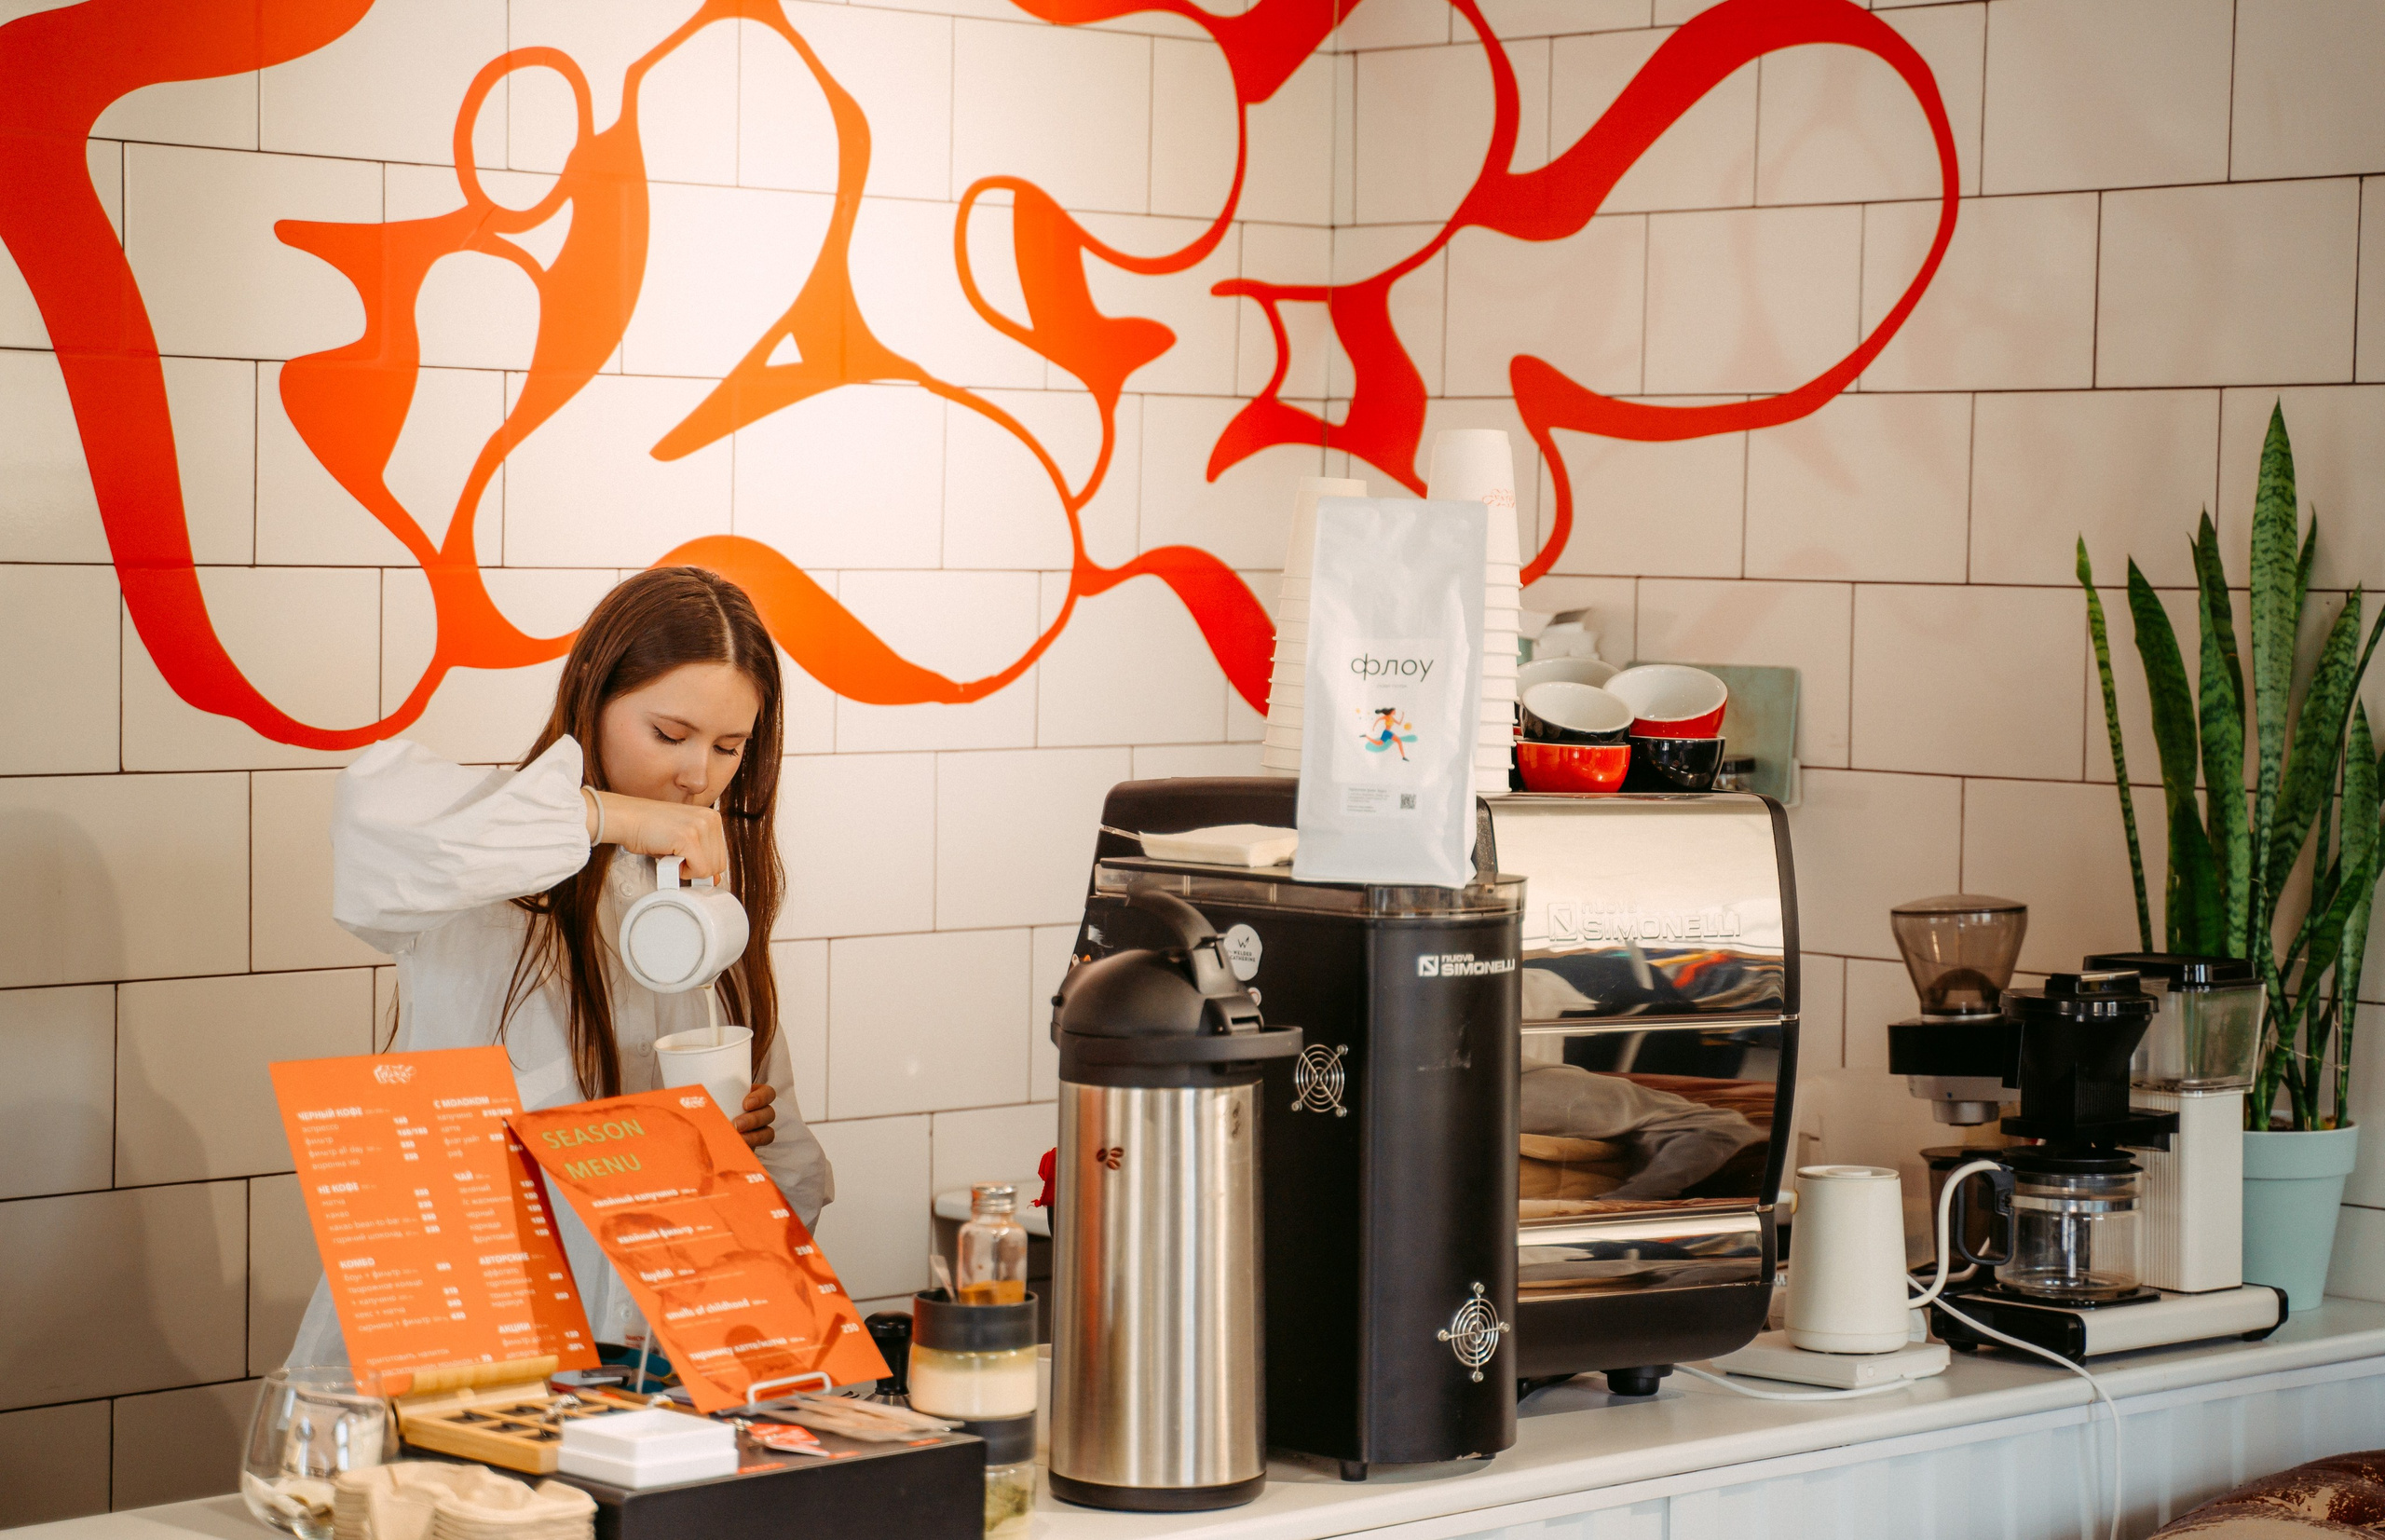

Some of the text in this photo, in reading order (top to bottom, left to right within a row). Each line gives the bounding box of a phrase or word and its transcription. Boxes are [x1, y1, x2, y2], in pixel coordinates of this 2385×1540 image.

[1352, 653, 1434, 682] флоу
[1584, 914, 1741, 941] SIMONELLI
[1442, 954, 1475, 963] nuova
[1442, 959, 1516, 977] SIMONELLI
[442, 1097, 490, 1108] МОЛОКОМ
[298, 1109, 334, 1121] ЧЕРНЫЙ
[336, 1107, 363, 1117] КОФЕ
[438, 1112, 473, 1121] капучино
[542, 1118, 647, 1150] SEASON
[306, 1137, 334, 1146] фильтр
[309, 1149, 337, 1158] фильтр
[350, 1145, 363, 1154] day
[448, 1150, 463, 1158] раф
[313, 1161, 347, 1169] воронка
[565, 1153, 642, 1180] MENU
[454, 1171, 473, 1182] ЧАЙ
[318, 1186, 331, 1194] НЕ
[333, 1182, 359, 1192] КОФЕ
[635, 1189, 679, 1202] капучино
[334, 1233, 366, 1245] горячий
[369, 1232, 403, 1241] шоколад
[660, 1225, 694, 1240] фильтр
[340, 1258, 375, 1269] КОМБО
[480, 1252, 530, 1265] АВТОРСКИЕ
[374, 1269, 401, 1279] фильтр
[348, 1280, 424, 1294] творожное кольцо
[360, 1296, 397, 1305] капучино
[666, 1307, 695, 1321] smells
[696, 1305, 706, 1315] of
[706, 1298, 751, 1314] childhood
[359, 1322, 394, 1332] сырники
[403, 1317, 431, 1327] фильтр
[498, 1323, 531, 1334] АКЦИИ
[503, 1338, 530, 1347] фильтр
[689, 1346, 734, 1361] тирамису
[735, 1337, 788, 1352] латте/матча
[368, 1349, 450, 1366] приготовить напиток
